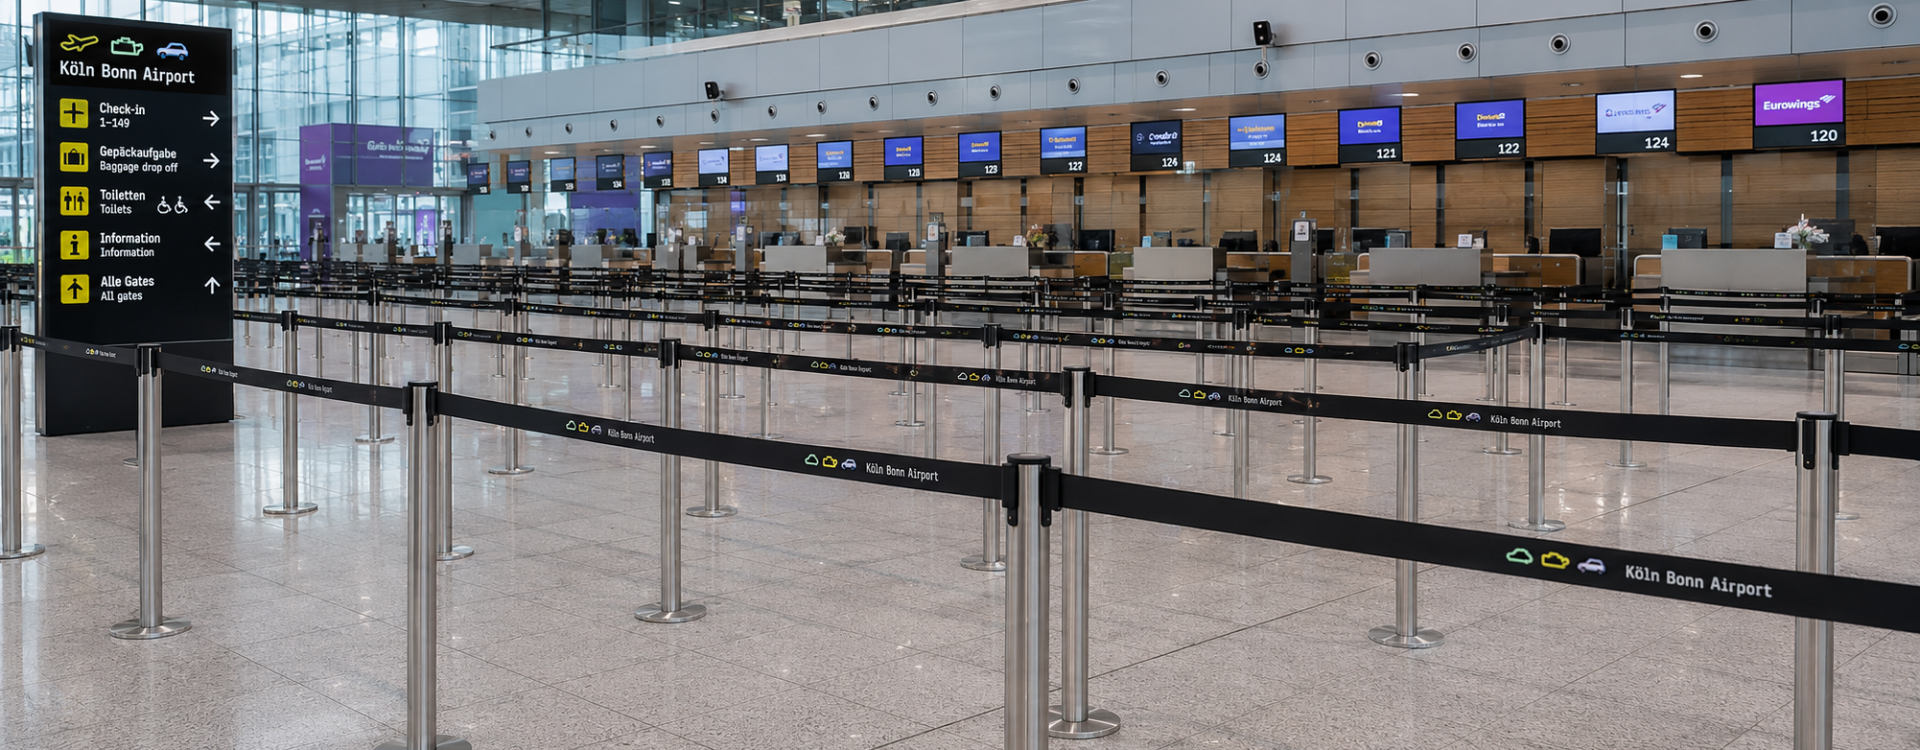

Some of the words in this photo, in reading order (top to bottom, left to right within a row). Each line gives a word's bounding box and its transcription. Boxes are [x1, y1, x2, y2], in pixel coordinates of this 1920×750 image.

[60, 60, 94, 77] Köln
[102, 63, 137, 80] Bonn
[143, 66, 195, 86] Airport
[100, 102, 145, 115] Check-in
[1763, 99, 1820, 111] Eurowings
[1810, 129, 1838, 143] 120
[1645, 136, 1670, 149] 124
[100, 145, 177, 161] Gepäckaufgabe
[1376, 148, 1397, 159] 121
[1498, 143, 1520, 155] 122
[1264, 152, 1282, 164] 124
[100, 160, 139, 174] Baggage
[142, 162, 162, 174] drop
[165, 162, 178, 172] off
[100, 189, 146, 201] Toiletten
[100, 204, 132, 214] Toilets
[100, 232, 161, 244] Information
[100, 247, 154, 257] Information
[100, 276, 122, 287] Alle
[124, 276, 155, 287] Gates
[100, 291, 114, 301] All
[118, 291, 143, 303] gates
[1260, 397, 1282, 407] Airport
[1490, 414, 1508, 424] Köln
[1510, 416, 1529, 426] Bonn
[1532, 417, 1561, 429] Airport
[866, 462, 883, 475] Köln
[886, 464, 905, 477] Bonn
[908, 468, 939, 482] Airport
[1625, 565, 1660, 582] Köln
[1666, 570, 1704, 589] Bonn
[1710, 576, 1772, 598] Airport
